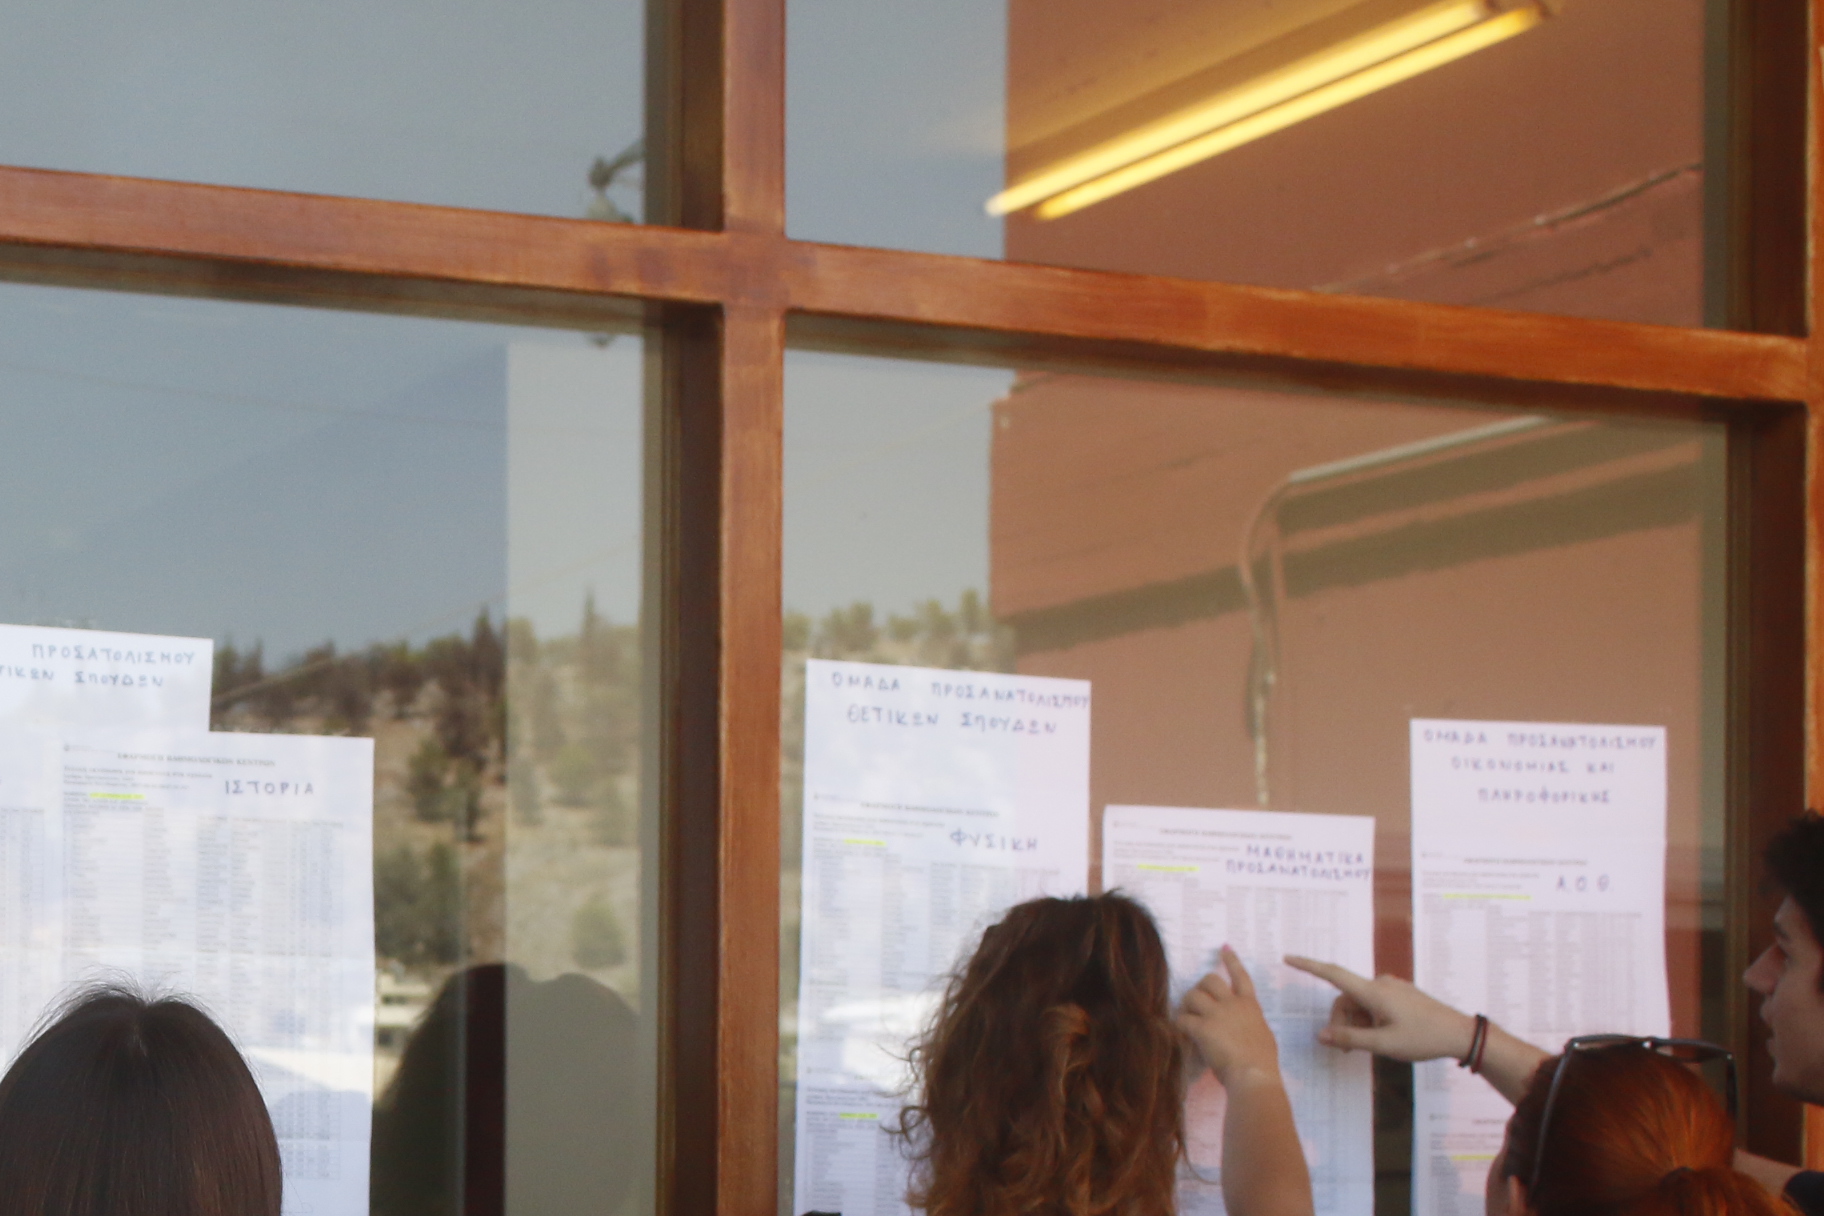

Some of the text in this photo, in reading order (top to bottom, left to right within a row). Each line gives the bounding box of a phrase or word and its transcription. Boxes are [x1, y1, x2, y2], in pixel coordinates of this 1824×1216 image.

[32, 643, 195, 666] ΠΡΟΣΑΤΟΛΙΣΜΟΥ
[74, 671, 164, 687] ΣΠΟΥΔΩΝ
[831, 671, 1090, 709] ΟΜΑΔΑ ΠΡΟΣΑΝΑΤΟΛΙΣΜΟΥ
[847, 703, 1057, 734] ΘΕΤΙΚΩΝ ΣΠΟΥΔΩΝ
[1423, 729, 1487, 745] ΟΜΑΔΑ
[1586, 761, 1615, 774] ΚΑΙ
[224, 779, 314, 796] ΙΣΤΟΡΙΑ
[949, 828, 1038, 851] ΦΥΣΙΚΗ
[1246, 844, 1363, 865] ΜΑΘΗΜΑΤΙΚΑ
